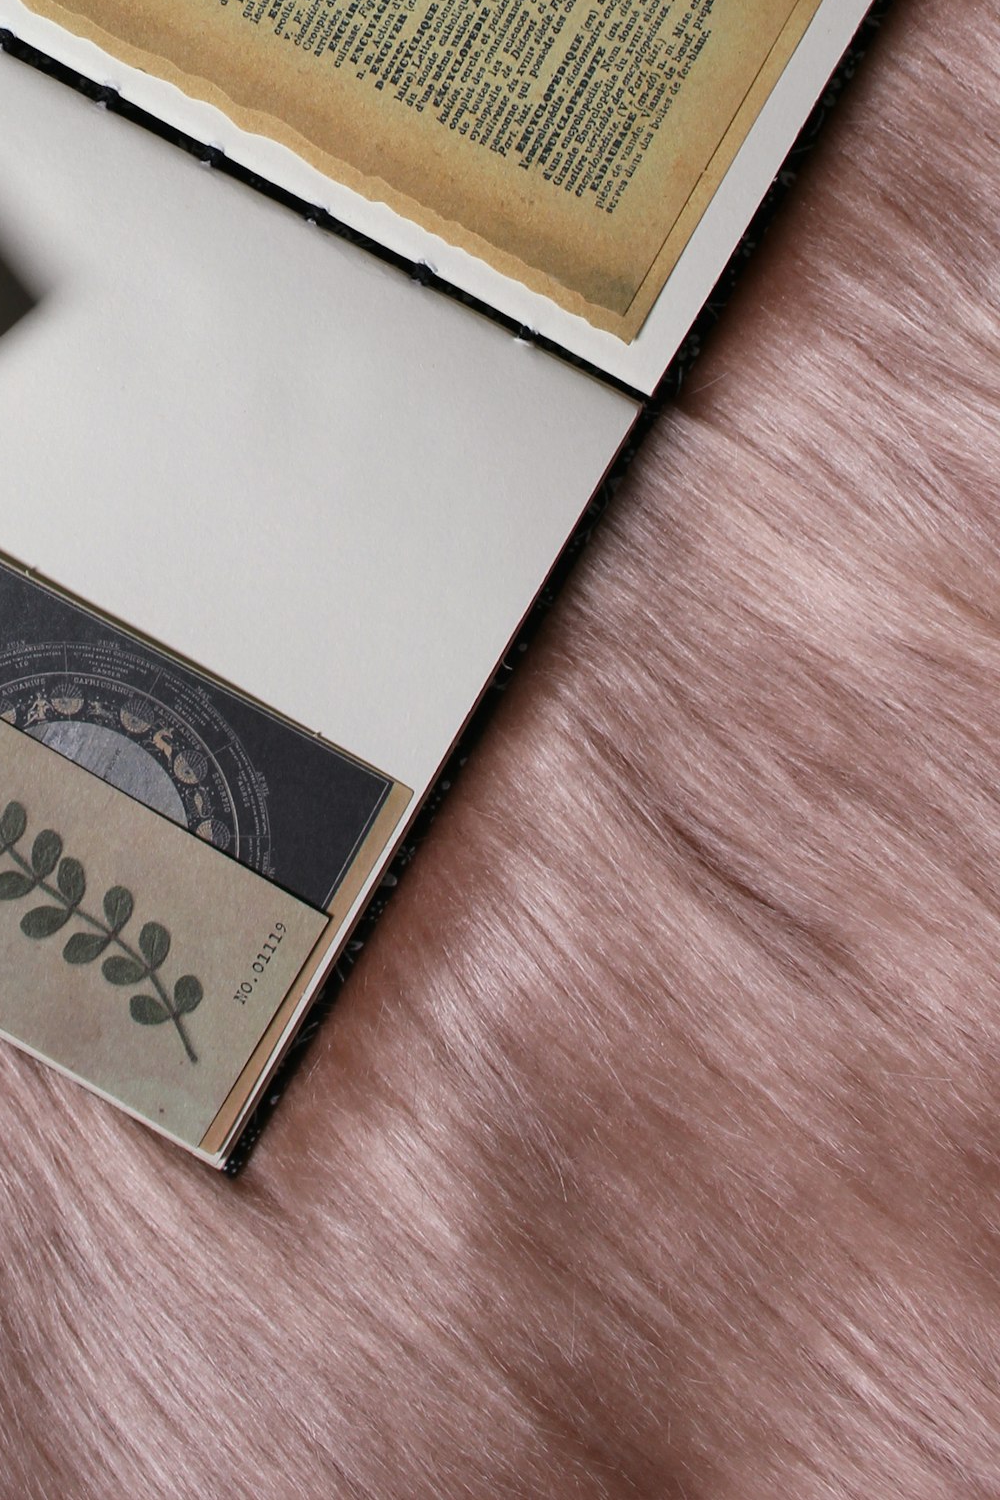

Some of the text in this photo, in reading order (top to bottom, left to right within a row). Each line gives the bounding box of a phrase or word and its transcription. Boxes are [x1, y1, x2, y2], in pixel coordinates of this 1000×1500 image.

[333, 23, 363, 68] cuirasse.
[369, 13, 408, 76] ENCUVER
[389, 2, 439, 88] ENCYCLIQUE
[432, 7, 491, 108] ENCYCLOPÉDIE
[510, 19, 538, 61] Diderot
[566, 20, 606, 89] dictionnaire
[676, 26, 712, 79] fer-blanc.
[514, 33, 585, 155] ENCYCLOPÉDIQUE
[536, 46, 606, 166] ENCYCLOPÉDISTE
[589, 111, 637, 192] ENDAUBAGE
[1, 678, 46, 697] AQUARIUS
[73, 677, 134, 698] CAPRICORNUS
[154, 706, 202, 751] SAGITTARIUS
[212, 772, 232, 813] SCORPIO
[233, 921, 285, 1004] NO.01119
